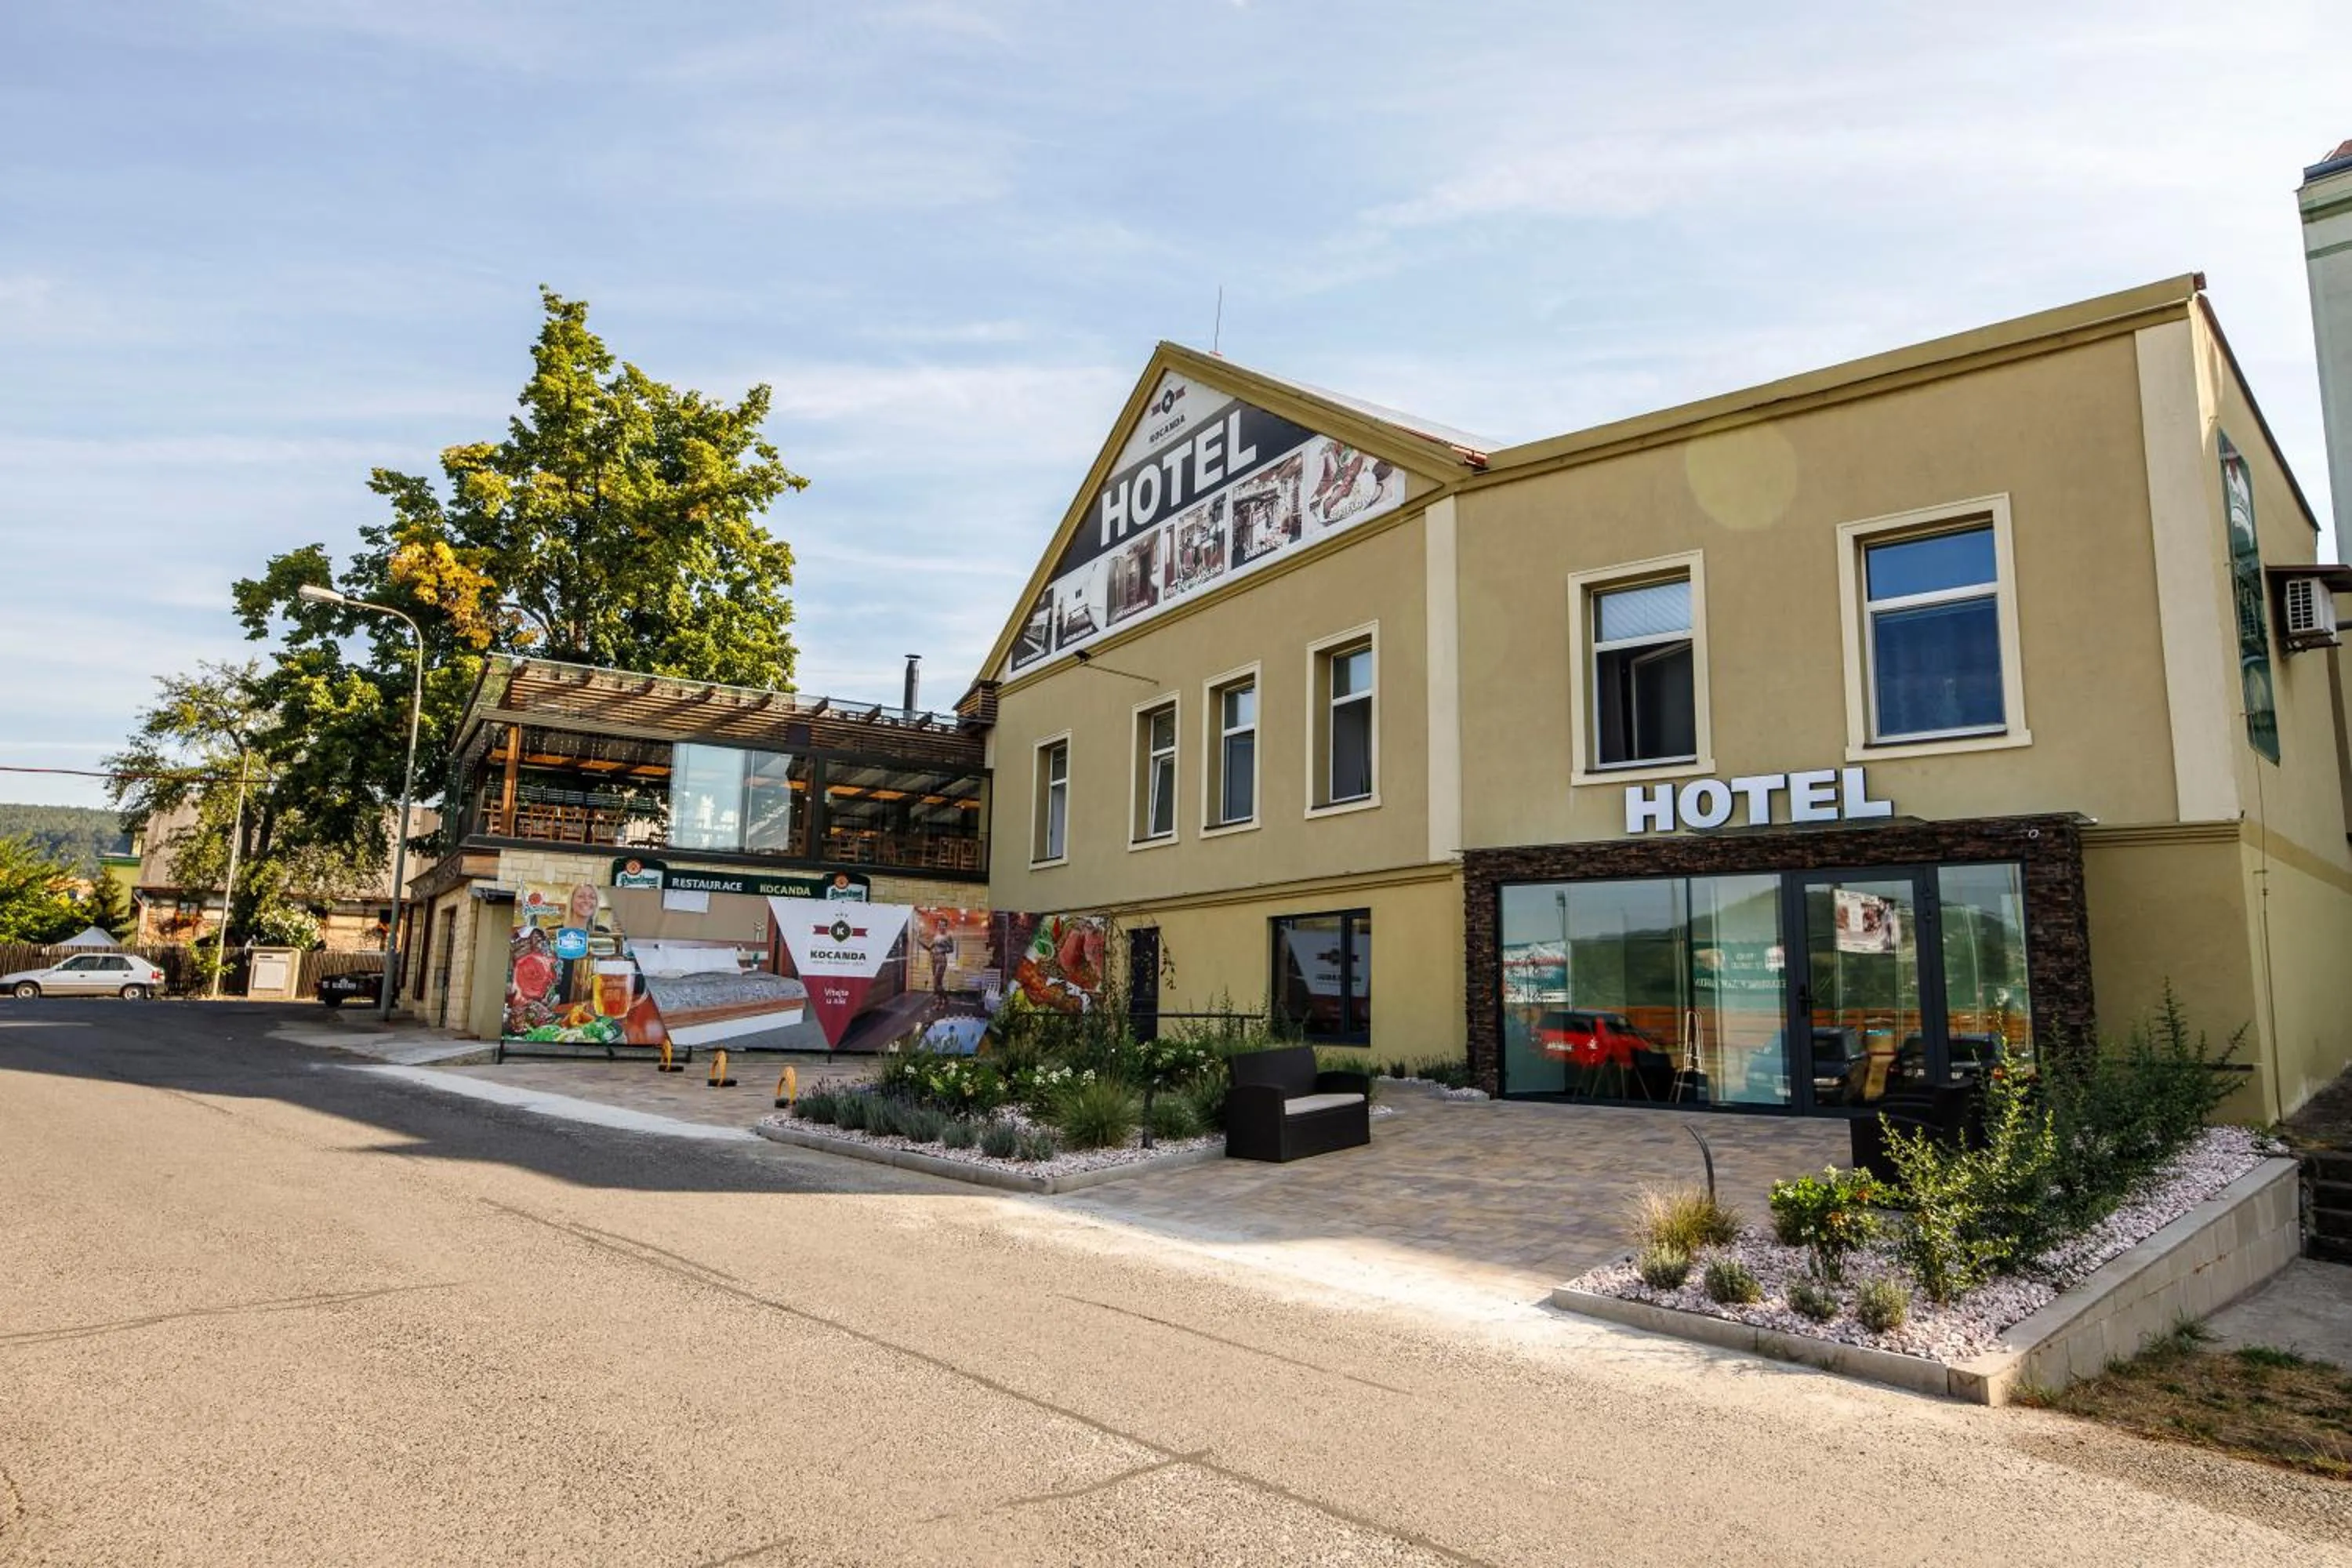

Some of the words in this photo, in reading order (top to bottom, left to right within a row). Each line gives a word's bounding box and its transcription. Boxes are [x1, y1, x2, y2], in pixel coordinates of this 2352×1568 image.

[1149, 413, 1185, 443] KOCANDA
[1101, 410, 1256, 546] HOTEL
[1626, 767, 1893, 833] HOTEL
[672, 877, 743, 891] RESTAURACE
[759, 883, 811, 896] KOCANDA
[810, 949, 866, 960] KOCANDA
